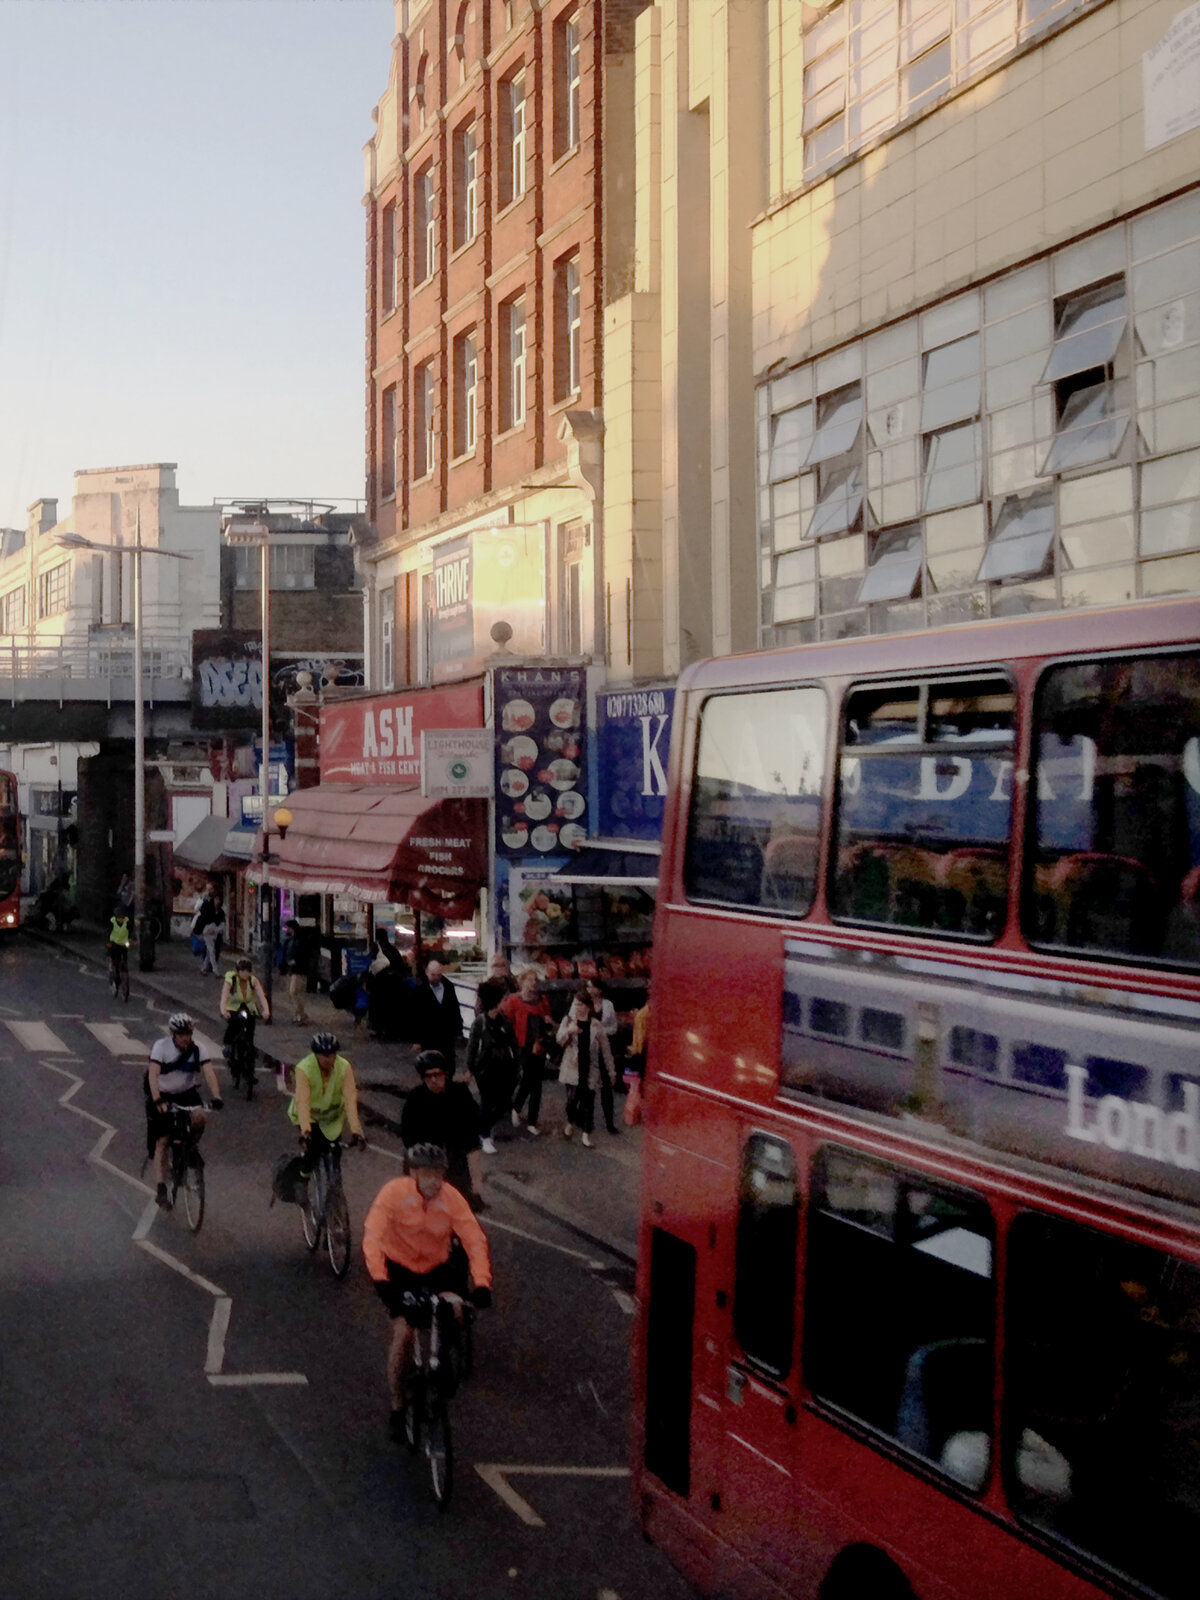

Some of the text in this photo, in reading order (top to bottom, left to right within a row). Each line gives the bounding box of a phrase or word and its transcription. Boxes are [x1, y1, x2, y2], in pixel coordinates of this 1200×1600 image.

[434, 557, 470, 609] THRIVE
[363, 705, 414, 758] ASH
[427, 740, 491, 751] LIGHTHOUSE
[378, 760, 396, 775] FISH
[409, 837, 472, 848] FRESH MEAT
[428, 851, 453, 862] FISH
